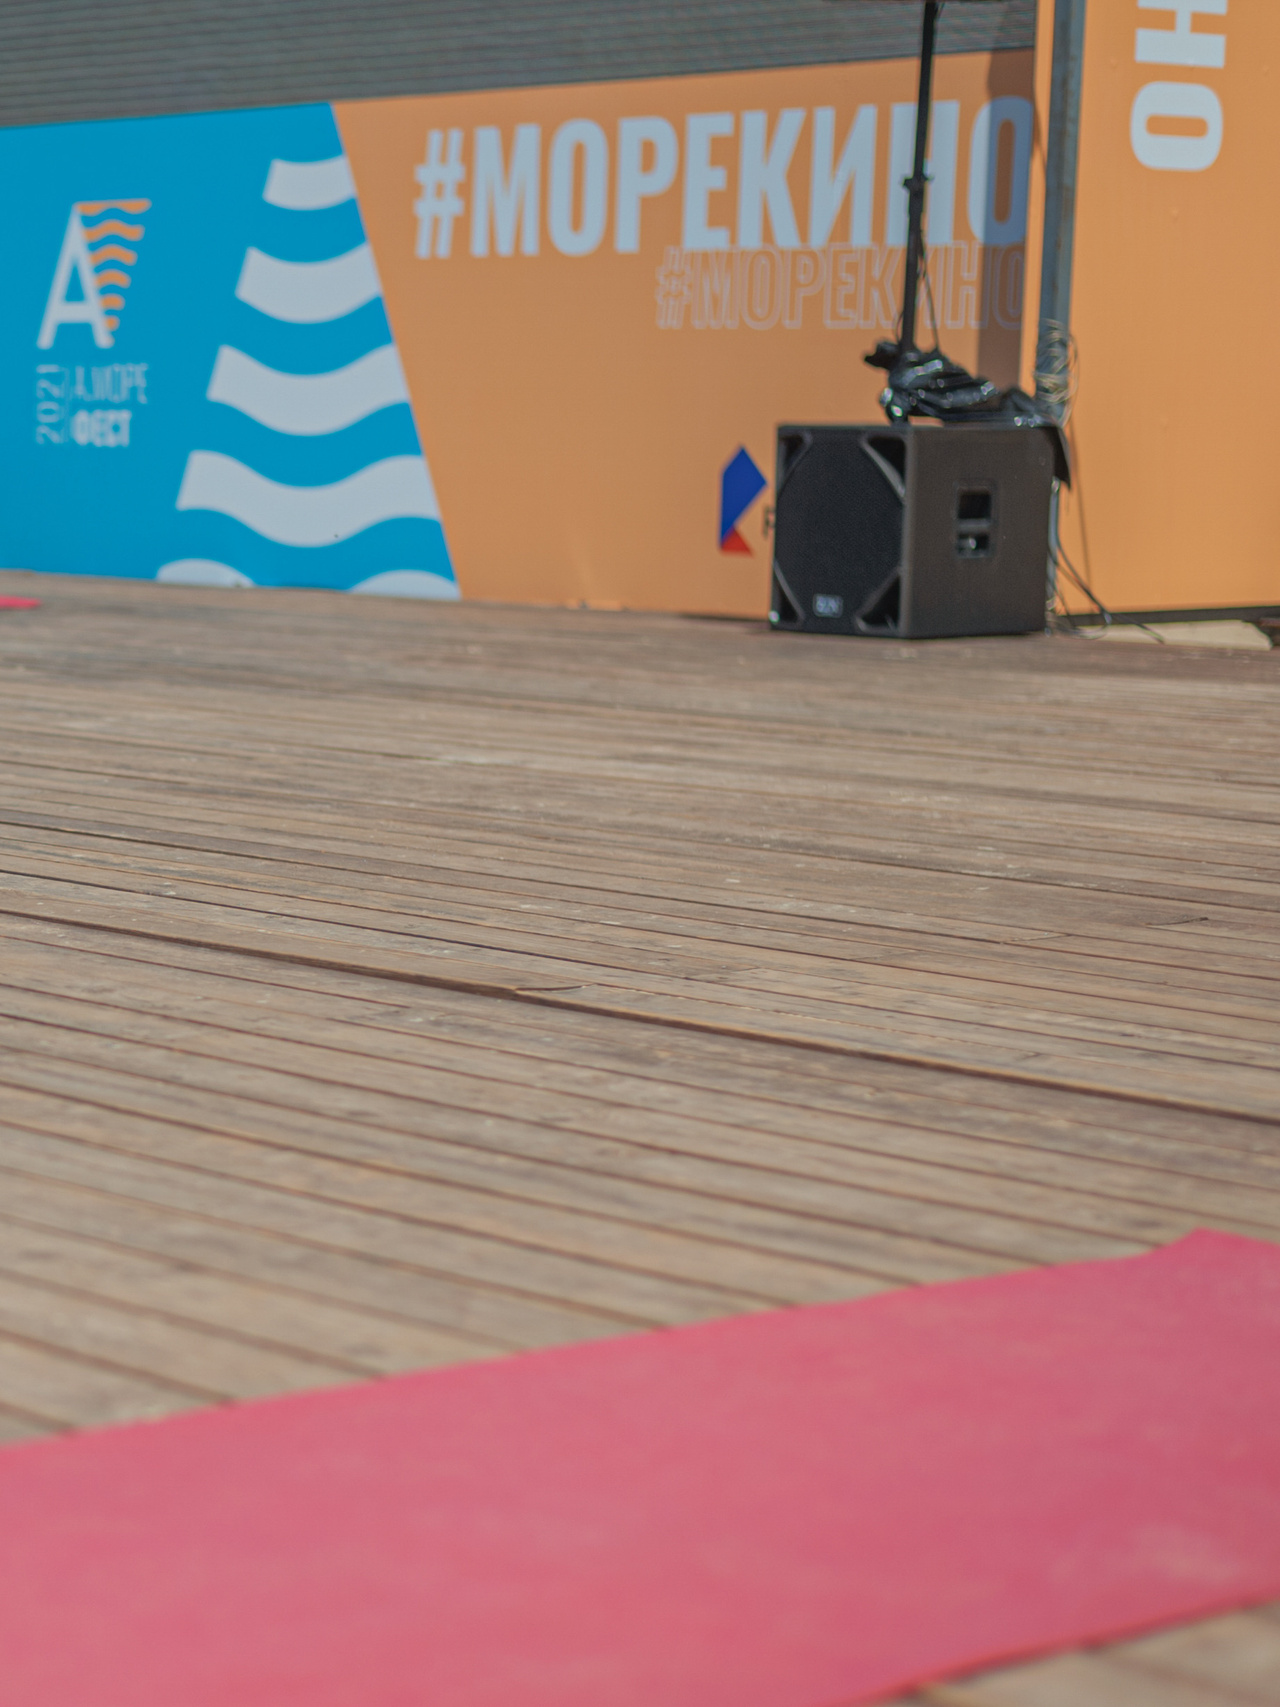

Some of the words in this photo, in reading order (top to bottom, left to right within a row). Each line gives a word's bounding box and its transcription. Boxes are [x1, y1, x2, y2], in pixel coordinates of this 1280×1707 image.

[413, 95, 1034, 260] #МОРЕКИНО
[35, 363, 65, 445] 2021
[70, 409, 132, 447] ФЕСТ
